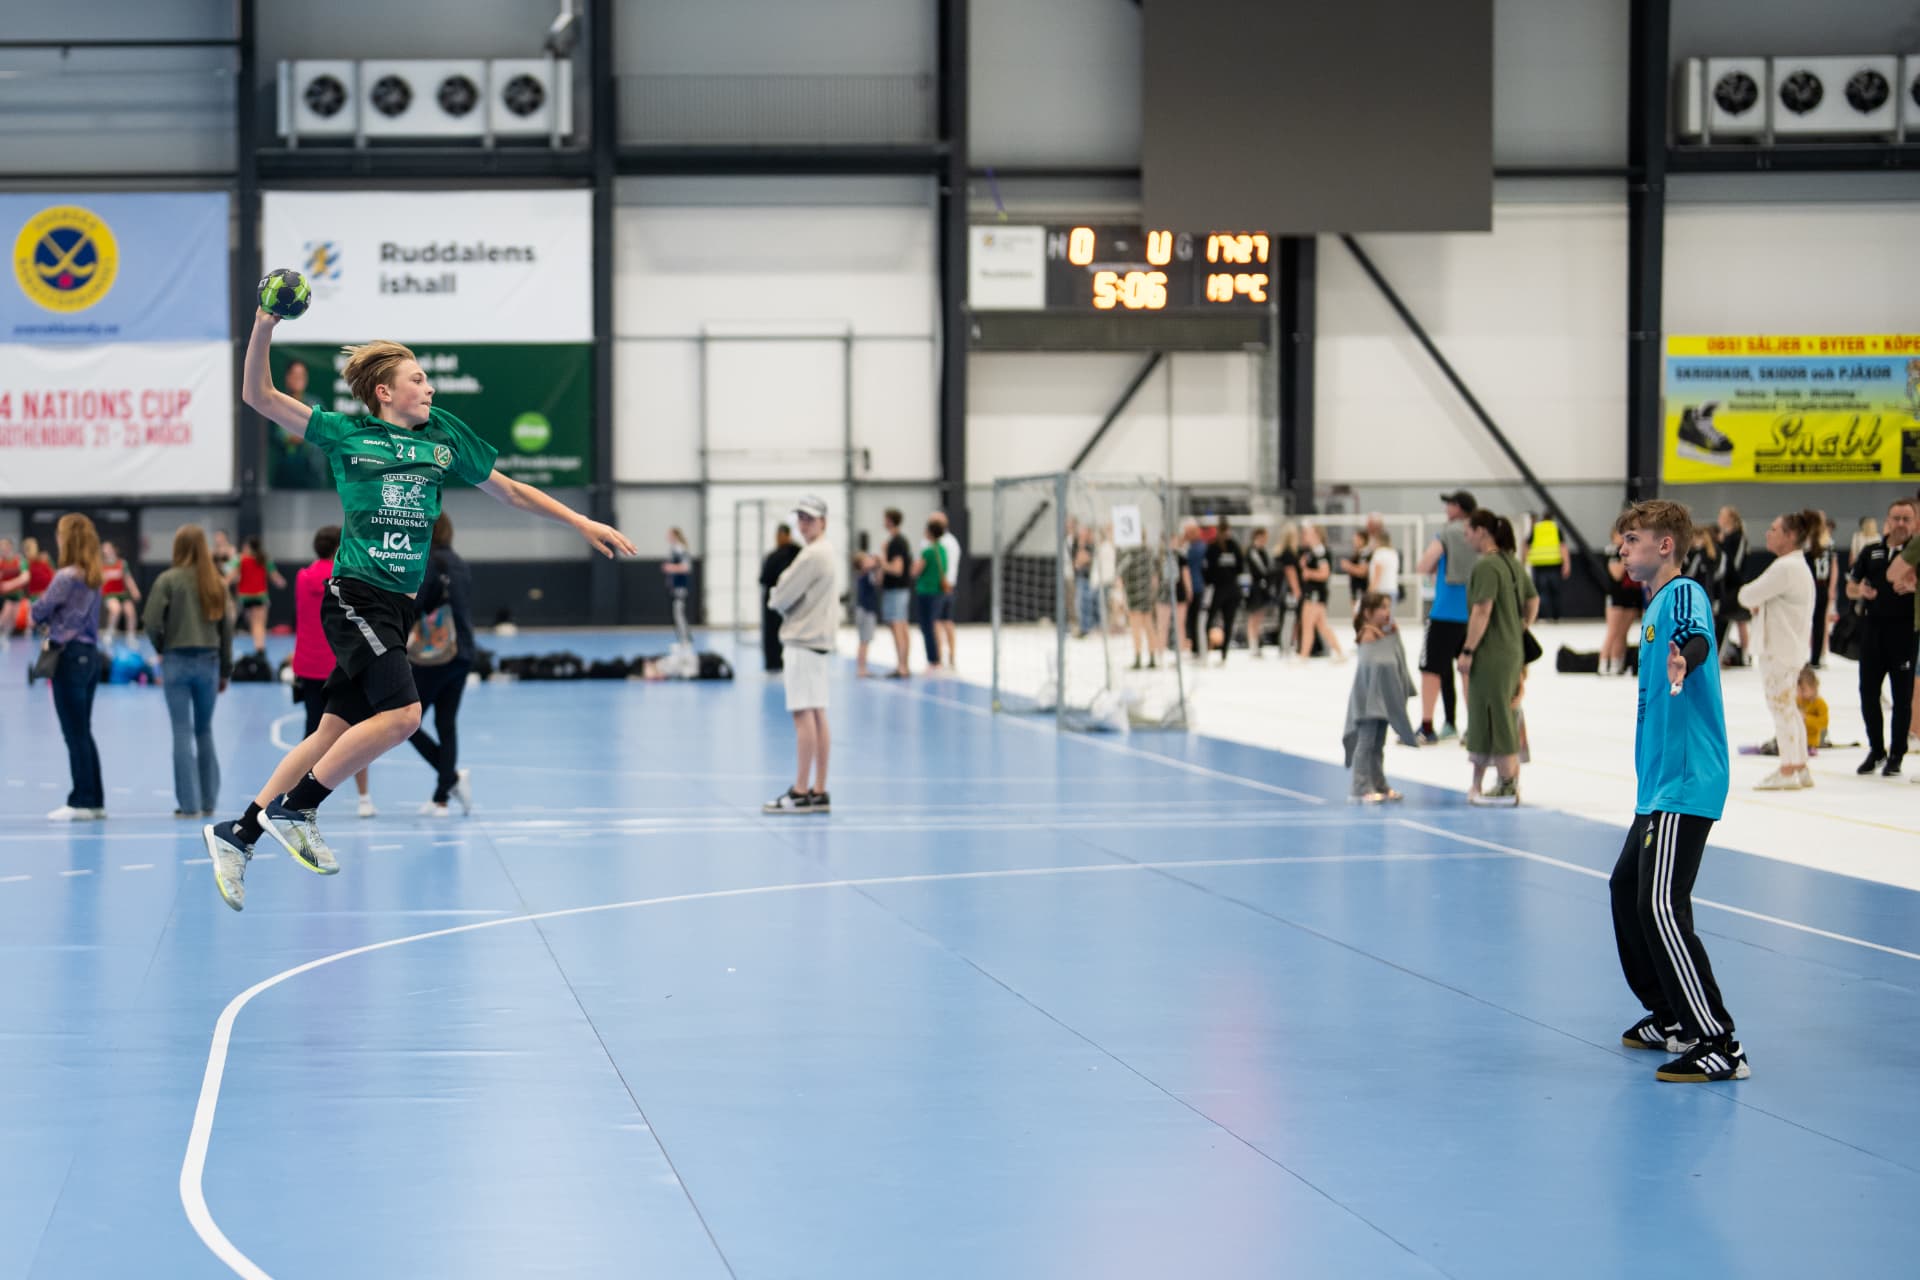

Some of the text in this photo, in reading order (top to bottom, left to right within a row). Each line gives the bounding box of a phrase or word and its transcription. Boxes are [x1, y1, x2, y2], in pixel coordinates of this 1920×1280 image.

[379, 242, 536, 264] Ruddalens
[1069, 226, 1095, 265] 0
[379, 271, 456, 294] ishall
[1092, 270, 1168, 309] 5:06
[1820, 336, 1865, 353] BYTER
[0, 389, 192, 420] 4 NATIONS CUP
[378, 508, 425, 519] STIFTELSEN
[383, 531, 412, 551] ICA
[388, 563, 405, 573] Tuve
